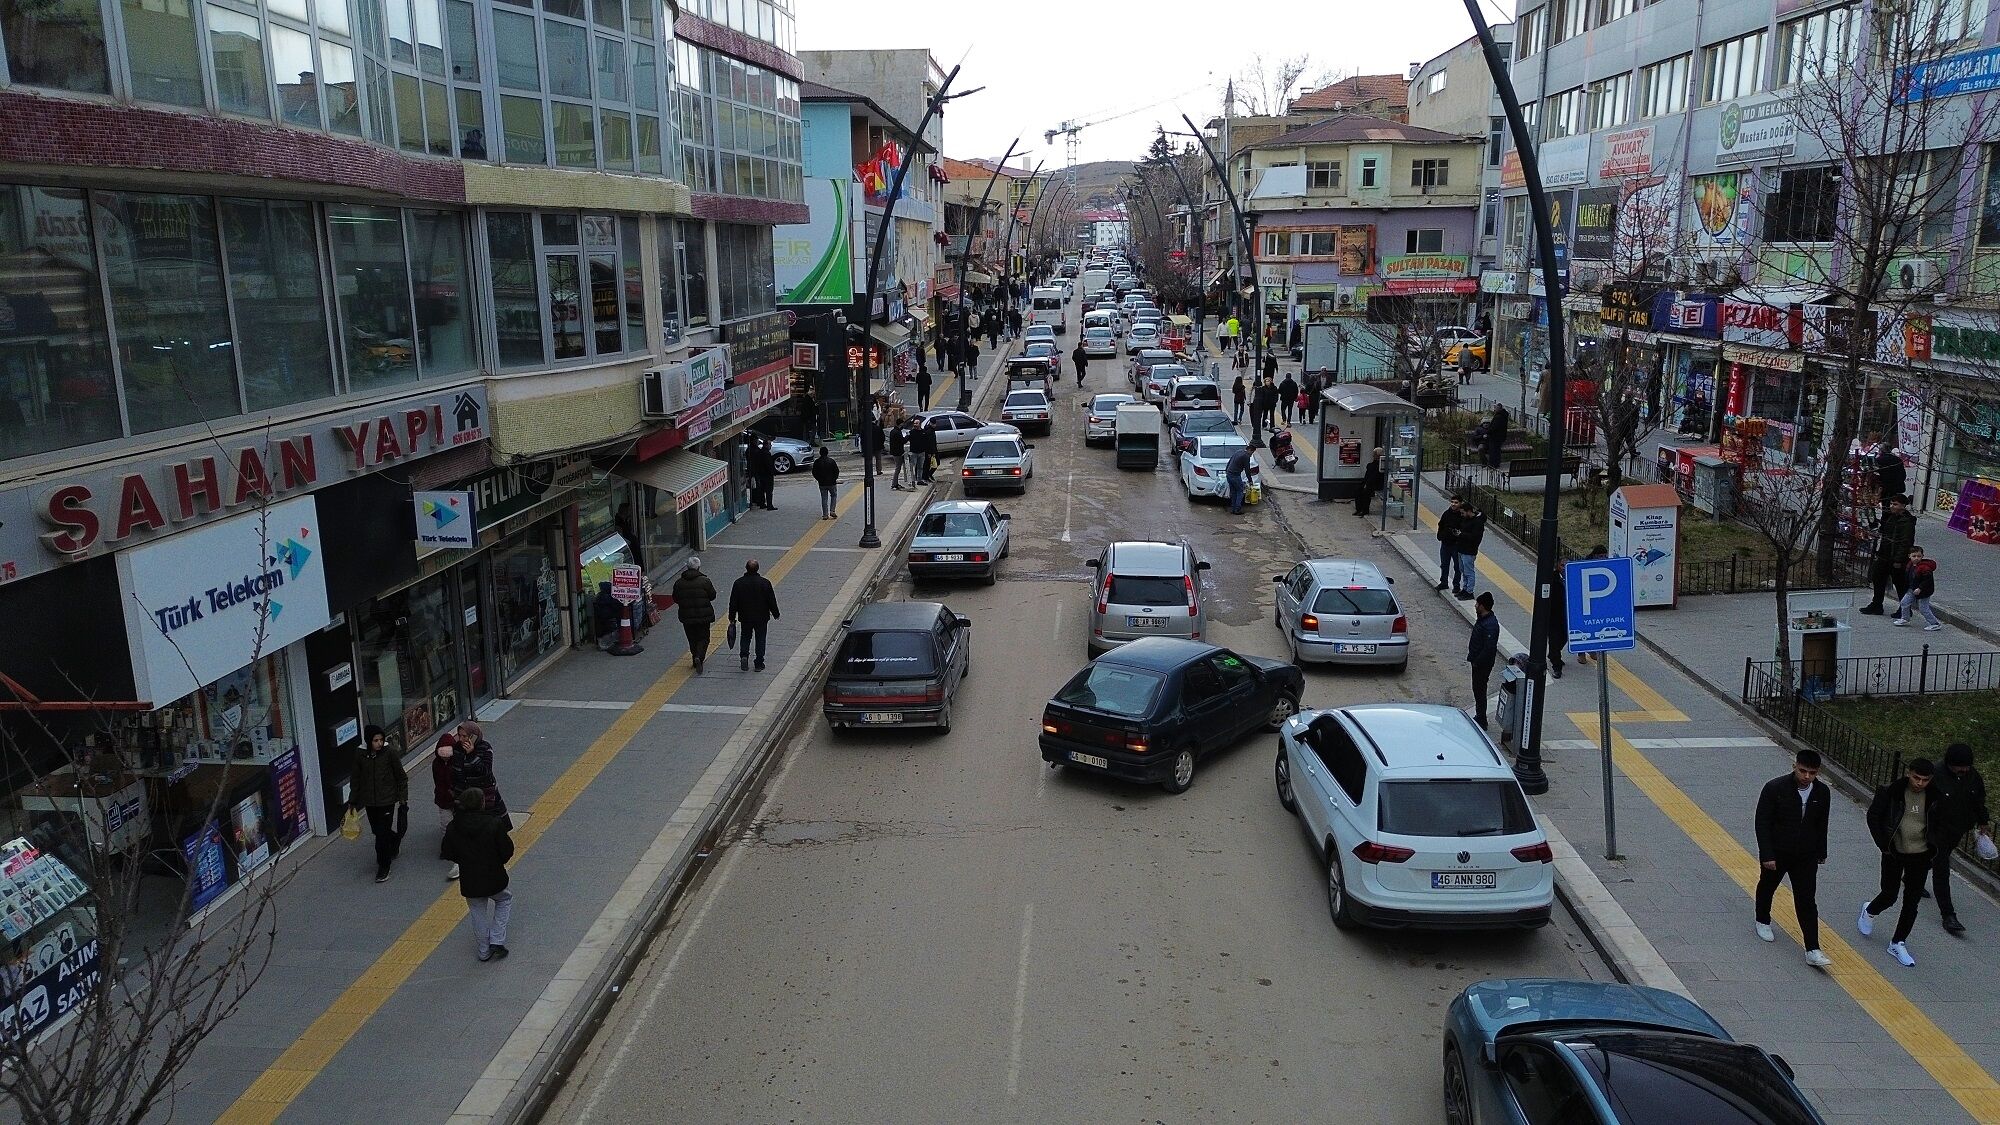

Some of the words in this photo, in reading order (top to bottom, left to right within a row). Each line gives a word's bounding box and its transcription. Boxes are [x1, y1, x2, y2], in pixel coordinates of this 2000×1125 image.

[1742, 109, 1756, 121] MD
[1739, 129, 1767, 144] Mustafa
[1386, 257, 1425, 275] SULTAN
[1600, 306, 1617, 321] KILIF
[750, 370, 789, 411] CZANE
[338, 404, 445, 471] YAPI
[44, 433, 317, 560] ŞAHAN
[438, 535, 468, 543] Telekom
[1581, 567, 1617, 616] P
[155, 597, 205, 634] Türk
[205, 569, 284, 613] Telekom
[864, 713, 873, 721] 46
[886, 713, 902, 721] 1398
[1091, 756, 1107, 767] 0109
[1438, 875, 1450, 885] 46
[1454, 875, 1473, 885] ANN
[1475, 875, 1494, 885] 980
[58, 940, 99, 982] ALIM
[57, 970, 102, 1014] SATI
